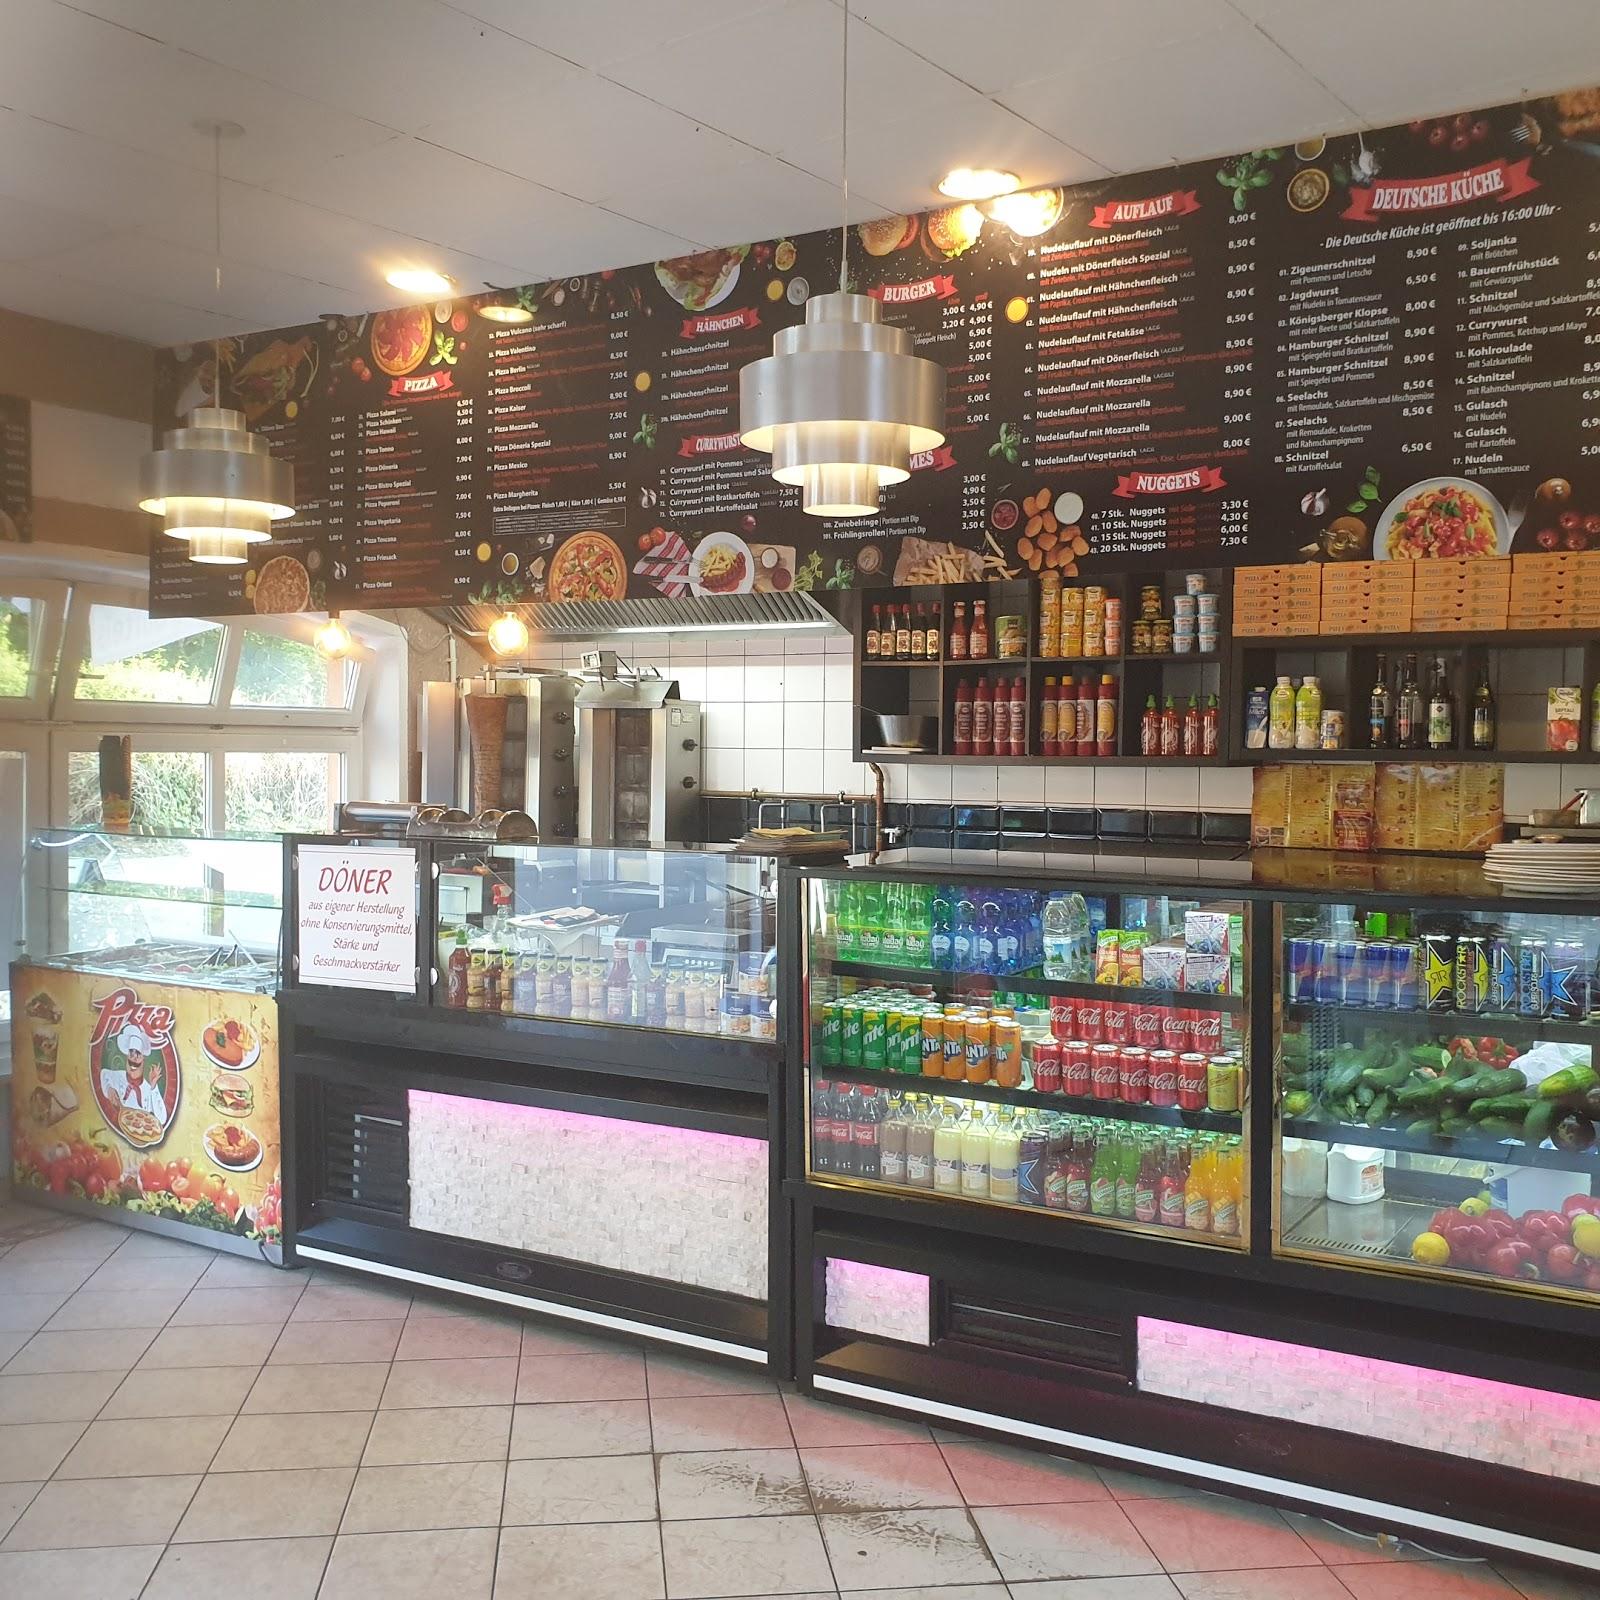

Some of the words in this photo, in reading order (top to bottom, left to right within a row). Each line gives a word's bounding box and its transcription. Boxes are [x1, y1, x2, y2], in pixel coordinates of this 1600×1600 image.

[1372, 182, 1449, 210] DEUTSCHE
[1450, 169, 1504, 201] KÜCHE
[1113, 196, 1174, 220] AUFLAUF
[1325, 237, 1341, 249] Die
[1343, 230, 1388, 247] Deutsche
[1389, 225, 1419, 240] Küche
[1421, 222, 1434, 235] ist
[1436, 216, 1481, 235] geöffnet
[1483, 212, 1499, 225] bis
[1502, 206, 1533, 222] 16:00
[1534, 203, 1555, 216] Uhr
[1470, 235, 1517, 250] Soljanka
[1407, 248, 1429, 259] 8,90
[1040, 266, 1069, 279] Nudeln
[1070, 263, 1084, 273] mit
[1085, 256, 1138, 271] Dönerfleisch
[1139, 250, 1171, 265] Spezial
[1290, 255, 1376, 276] Zigeunerschnitzel
[1470, 255, 1560, 277] Bauernfrühstück
[883, 281, 936, 301] BURGER
[1039, 286, 1092, 302] Nudelauflauf
[1093, 283, 1107, 292] mit
[1108, 273, 1178, 291] Hähnchenfleisch
[1290, 286, 1339, 302] Jagdwurst
[1469, 289, 1518, 304] Schnitzel
[1039, 310, 1092, 326] Nudelauflauf
[1092, 307, 1107, 317] mit
[1107, 297, 1177, 315] Hähnchenfleisch
[1405, 301, 1427, 312] 8,00
[696, 314, 744, 332] HÄHNCHEN
[1289, 311, 1353, 327] Königsberger
[1354, 307, 1389, 320] Klopse
[1468, 316, 1528, 331] Currywurst
[1038, 334, 1092, 349] Nudelauflauf
[1092, 331, 1106, 341] mit
[1107, 326, 1145, 341] Fetakäse
[1289, 338, 1343, 352] Hamburger
[1344, 331, 1389, 344] Schnitzel
[1468, 342, 1533, 357] Kohlroulade
[1038, 357, 1091, 373] Nudelauflauf
[1091, 354, 1105, 364] mit
[1106, 348, 1159, 364] Dönerfleisch
[1288, 364, 1343, 377] Hamburger
[1343, 357, 1388, 371] Schnitzel
[403, 377, 438, 391] PIZZA
[1037, 380, 1090, 396] Nudelauflauf
[1090, 378, 1104, 388] mit
[1106, 374, 1151, 388] Mozzarella
[1467, 371, 1515, 384] Schnitzel
[1287, 390, 1328, 402] Seelachs
[1466, 398, 1508, 411] Gulasch
[1287, 416, 1328, 428] Seelachs
[1465, 426, 1507, 438] Gulasch
[696, 434, 740, 451] CURRYWURST
[1402, 443, 1424, 453] 6,50
[1479, 437, 1516, 448] Kartoffeln
[1035, 452, 1088, 466] Nudelauflauf
[1088, 448, 1137, 463] Vegetarisch
[1286, 450, 1329, 462] Schnitzel
[1464, 453, 1503, 465] Nudeln
[705, 462, 716, 470] mit
[716, 459, 743, 469] Pommes
[1286, 465, 1297, 473] mit
[1298, 461, 1342, 472] Kartoffelsalat
[1464, 468, 1478, 476] mit
[1479, 464, 1530, 474] Tomatensauce
[1136, 471, 1201, 491] NUGGETS
[704, 495, 715, 503] mit
[1108, 509, 1125, 518] Stk.
[1129, 507, 1166, 518] Nuggets
[1101, 521, 1111, 530] 10
[1113, 520, 1129, 530] Stk.
[1130, 518, 1166, 530] Nuggets
[1101, 533, 1111, 542] 15
[1113, 532, 1129, 541] Stk.
[1130, 530, 1166, 542] Nuggets
[1100, 544, 1111, 553] 20
[1112, 543, 1128, 553] Stk.
[1130, 541, 1166, 553] Nuggets
[319, 860, 392, 895] DÖNER
[308, 901, 323, 911] aus
[325, 900, 355, 915] eigener
[357, 901, 405, 919] Herstellung
[300, 918, 320, 928] ohne
[323, 918, 413, 937] Konservierungsmittel,
[333, 937, 360, 950] Stärke
[362, 940, 379, 951] und
[313, 954, 400, 972] Geschmackverstärker
[89, 987, 175, 1047] Pizza
